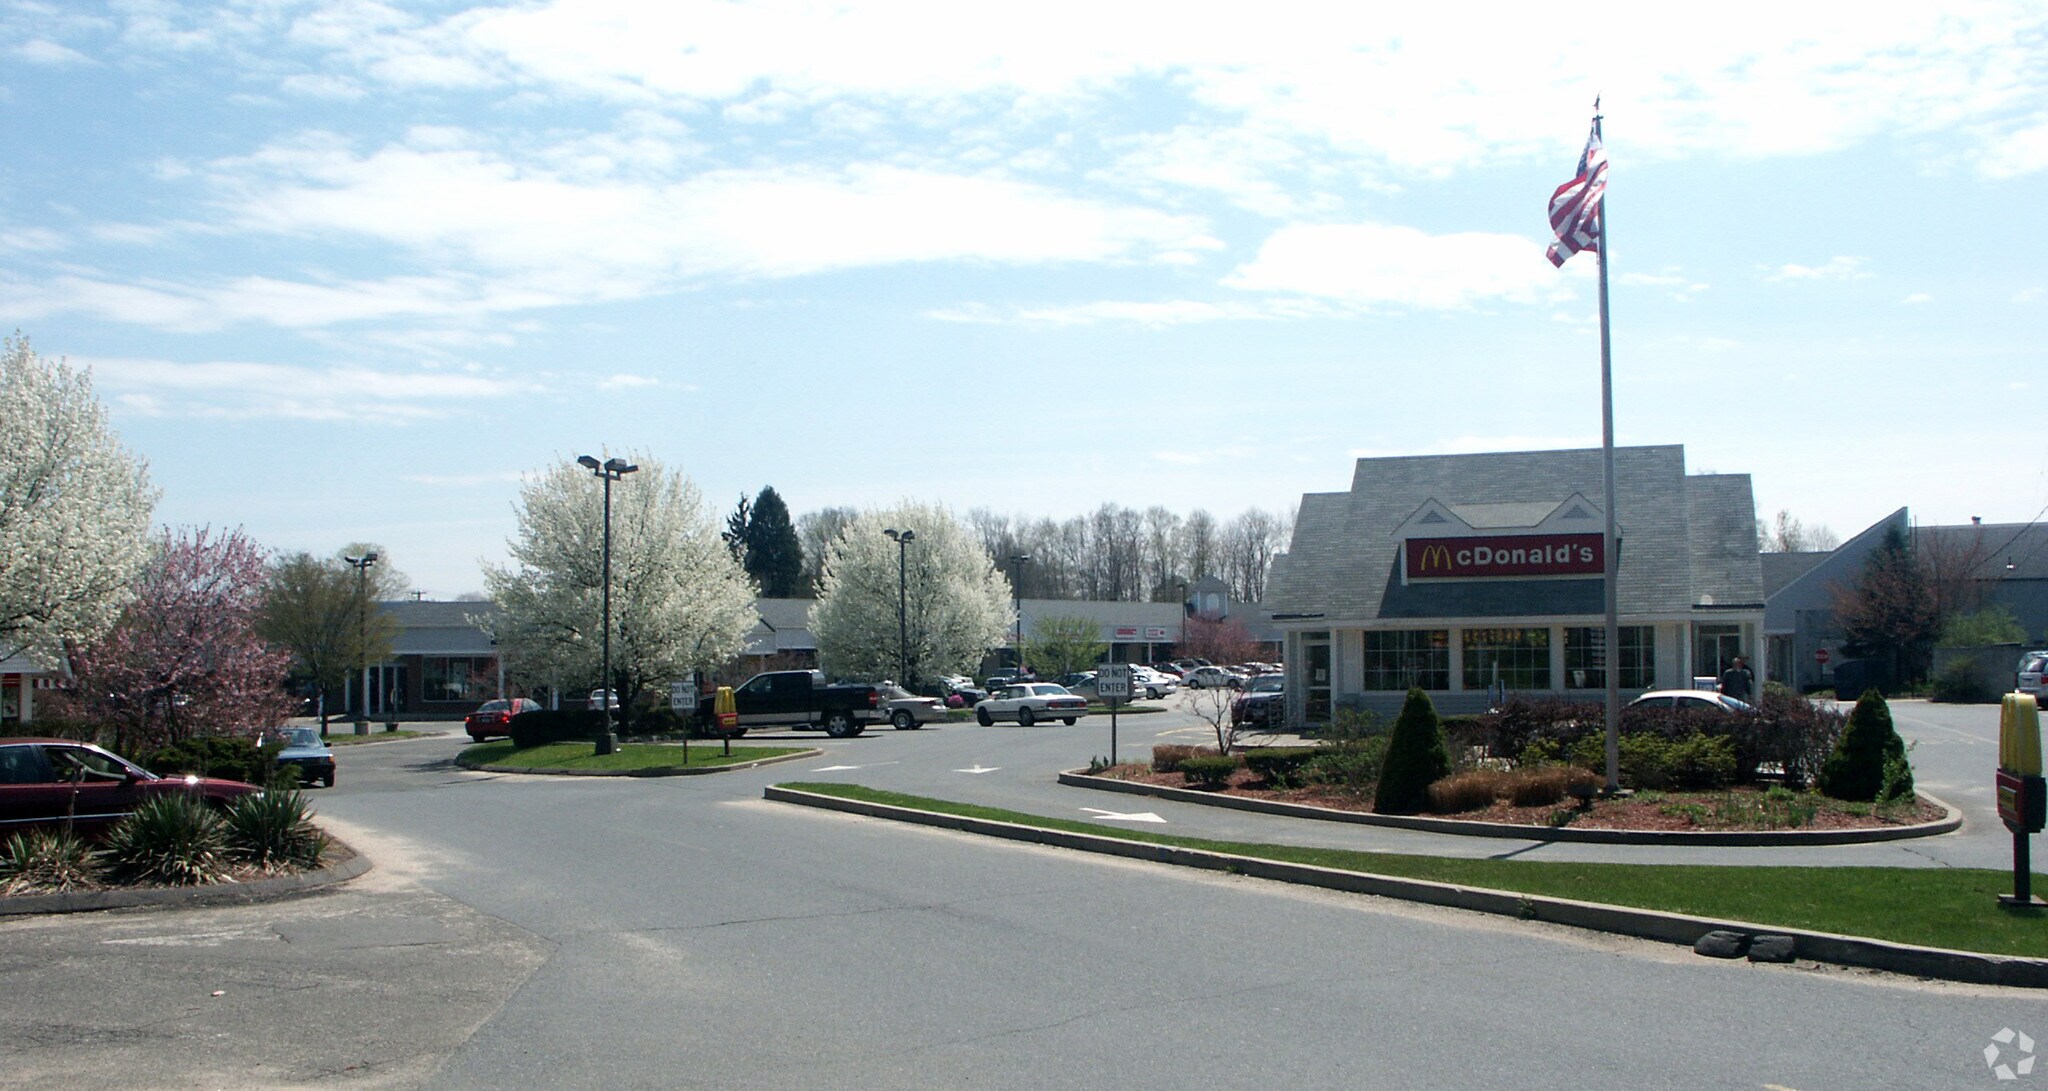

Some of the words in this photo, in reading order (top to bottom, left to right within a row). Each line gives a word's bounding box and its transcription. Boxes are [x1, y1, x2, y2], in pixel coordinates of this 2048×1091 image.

[1421, 544, 1594, 570] McDonald's
[1099, 668, 1110, 678] DO
[1112, 668, 1126, 678] NOT
[672, 685, 681, 693] DO
[682, 685, 694, 693] NOT
[1101, 683, 1126, 693] ENTER
[674, 697, 693, 705] ENTER
